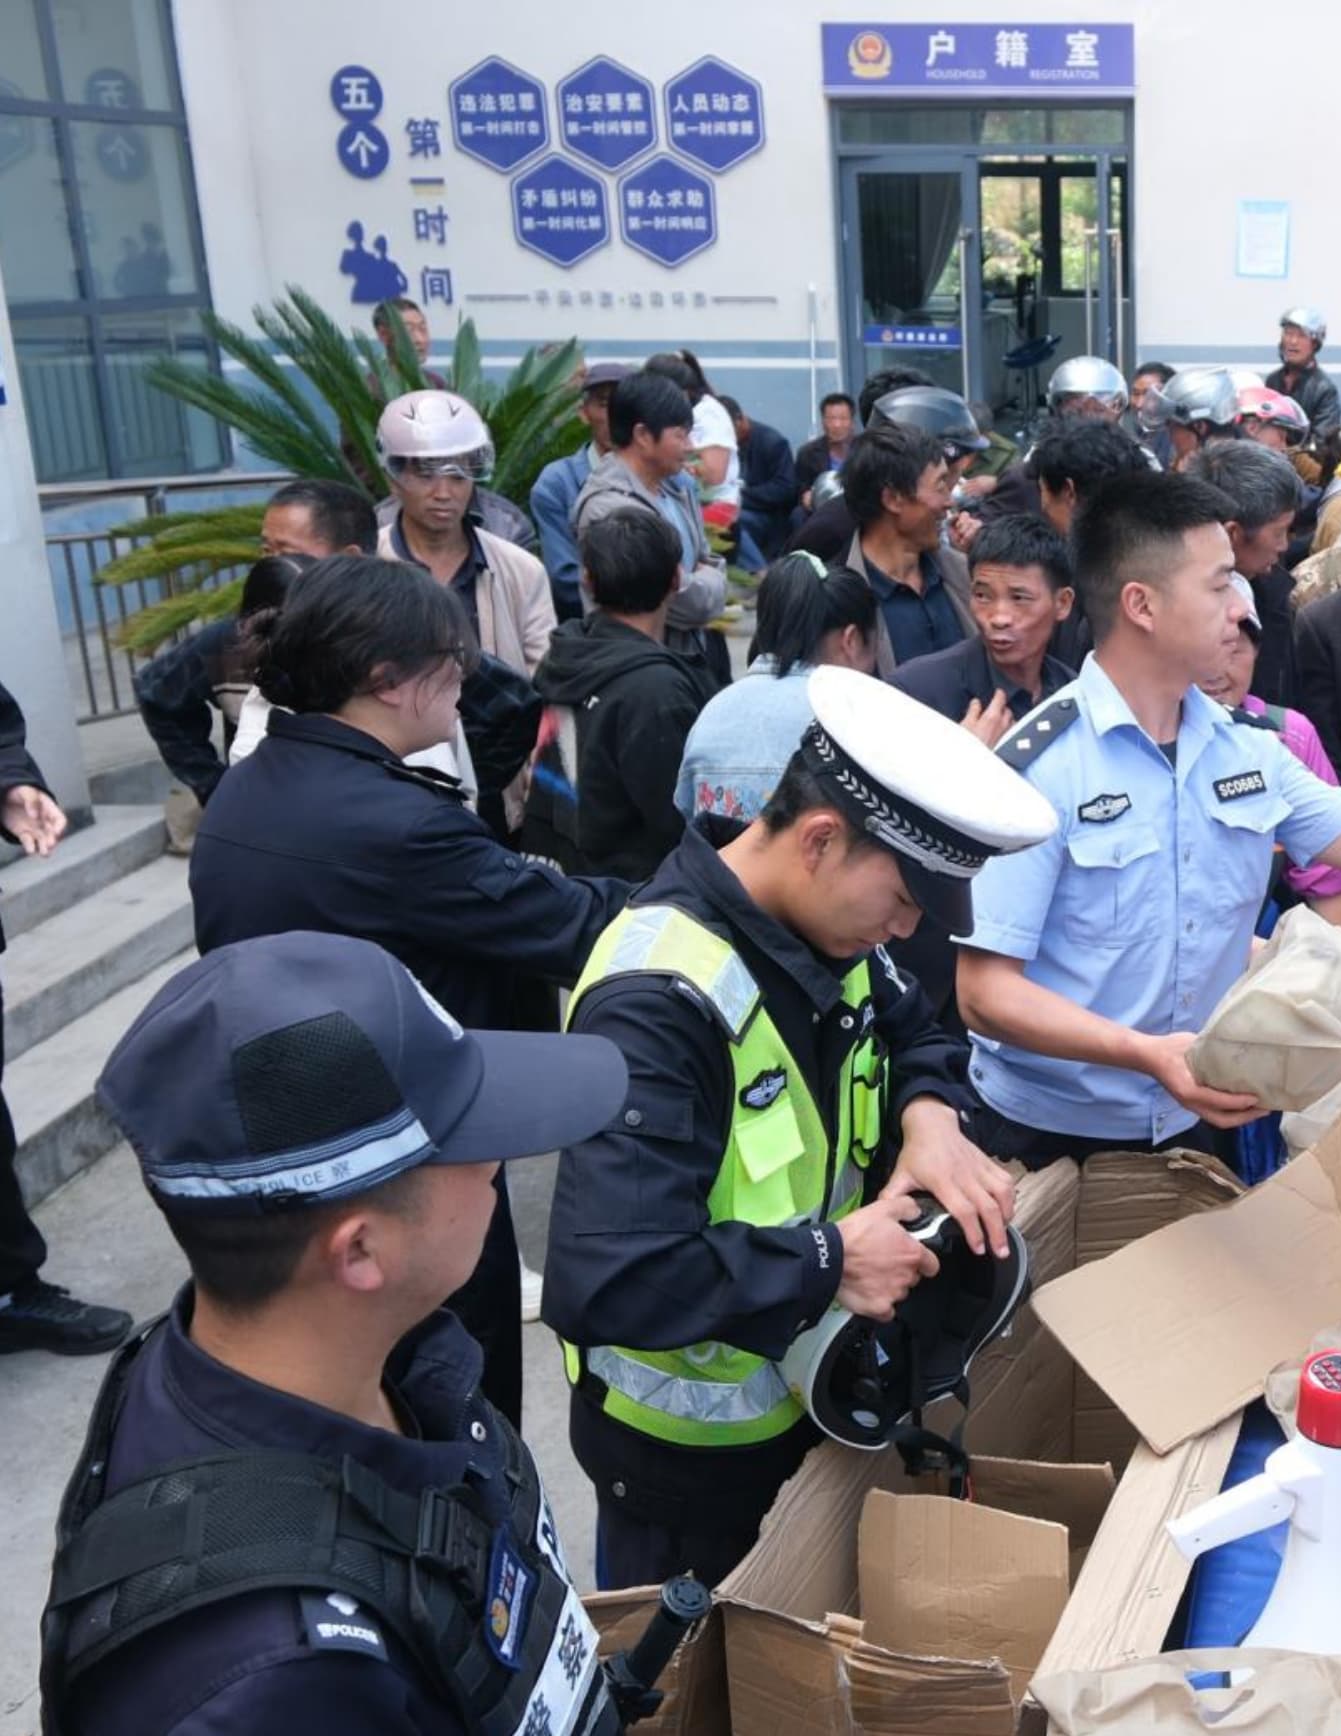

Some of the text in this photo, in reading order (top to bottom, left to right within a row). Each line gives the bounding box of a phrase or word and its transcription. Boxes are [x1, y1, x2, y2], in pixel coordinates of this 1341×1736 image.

[925, 30, 1099, 67] 户籍室
[926, 69, 1100, 81] HOUSEHOLD REGISTRATION
[459, 92, 536, 113] 违法犯罪
[673, 92, 750, 113] 人员动态
[341, 77, 379, 169] 五个
[405, 118, 454, 306] 第一时间
[626, 188, 705, 209] 群众求助
[811, 1228, 830, 1269] POLICE
